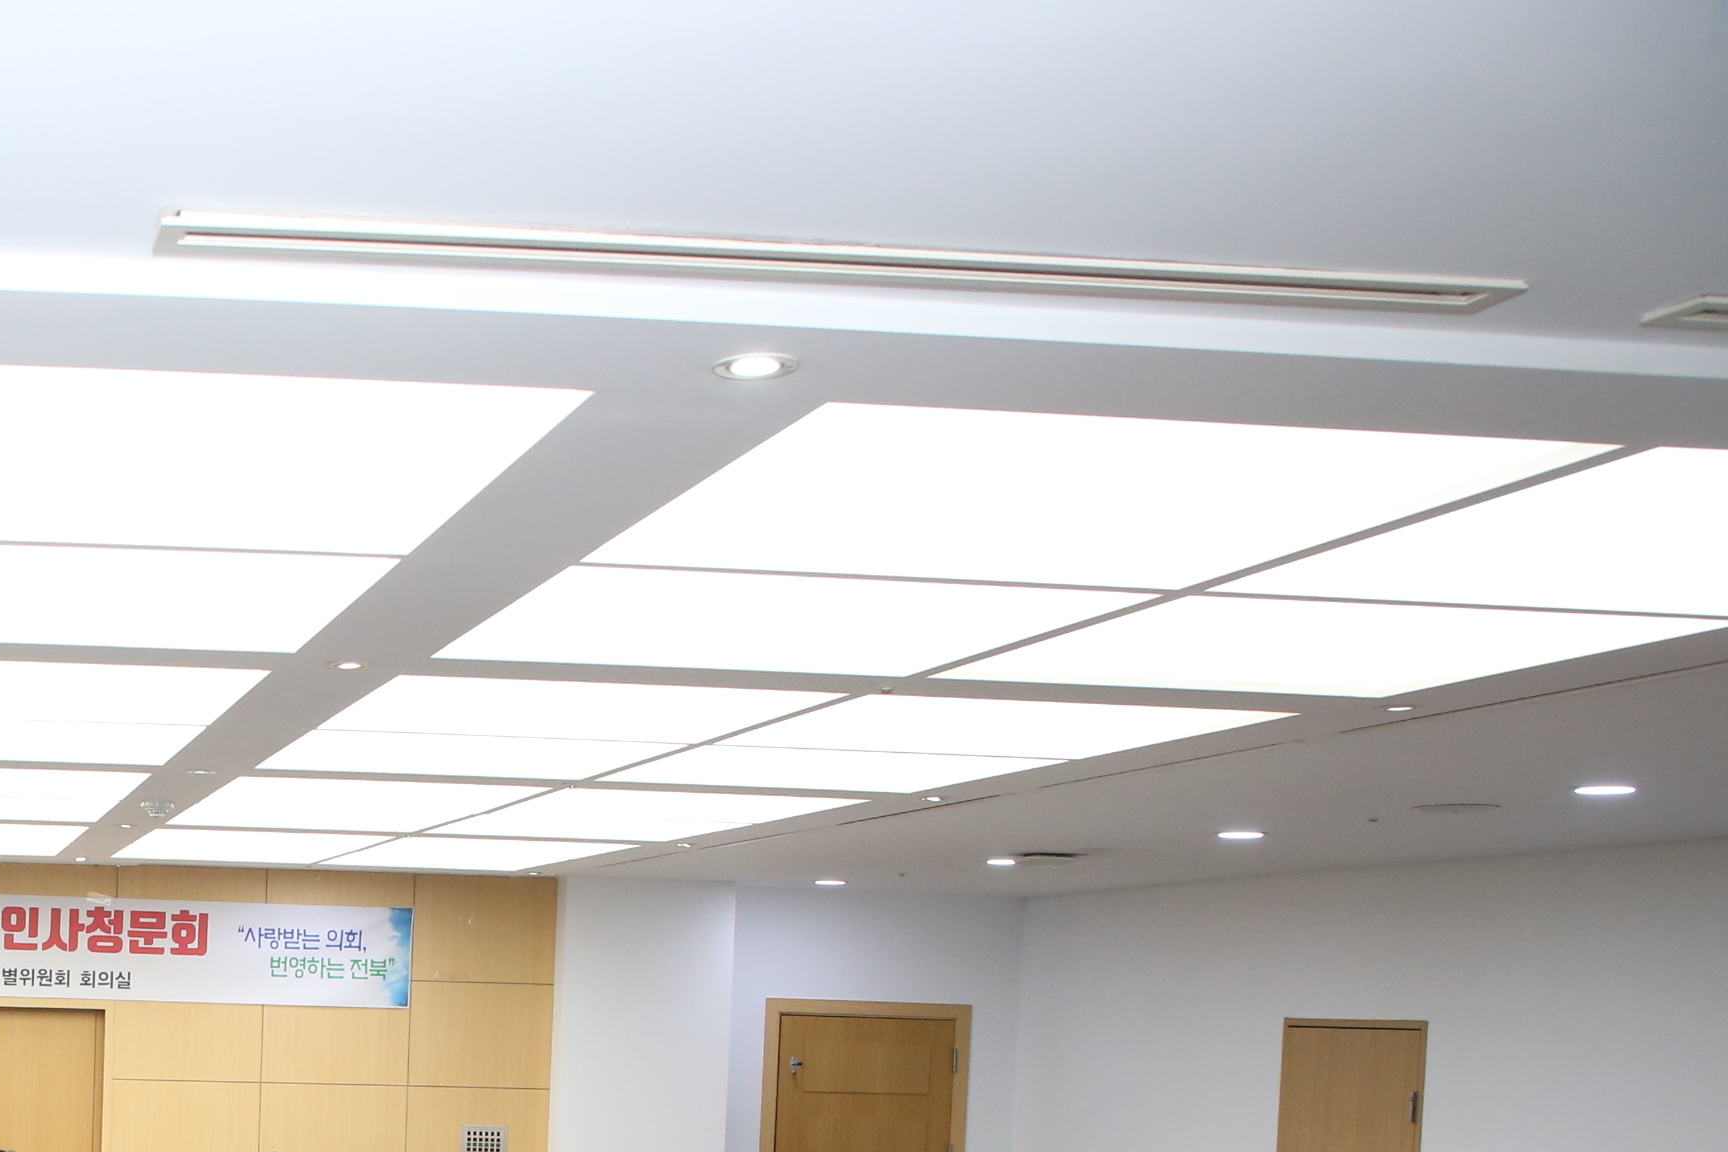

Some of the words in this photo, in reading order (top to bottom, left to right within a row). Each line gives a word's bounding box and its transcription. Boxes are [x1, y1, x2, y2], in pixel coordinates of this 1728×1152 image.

[0, 905, 209, 957] 인사청문회
[325, 928, 367, 954] 의회,
[79, 970, 131, 990] 회의실
[269, 956, 345, 980] 번영하는
